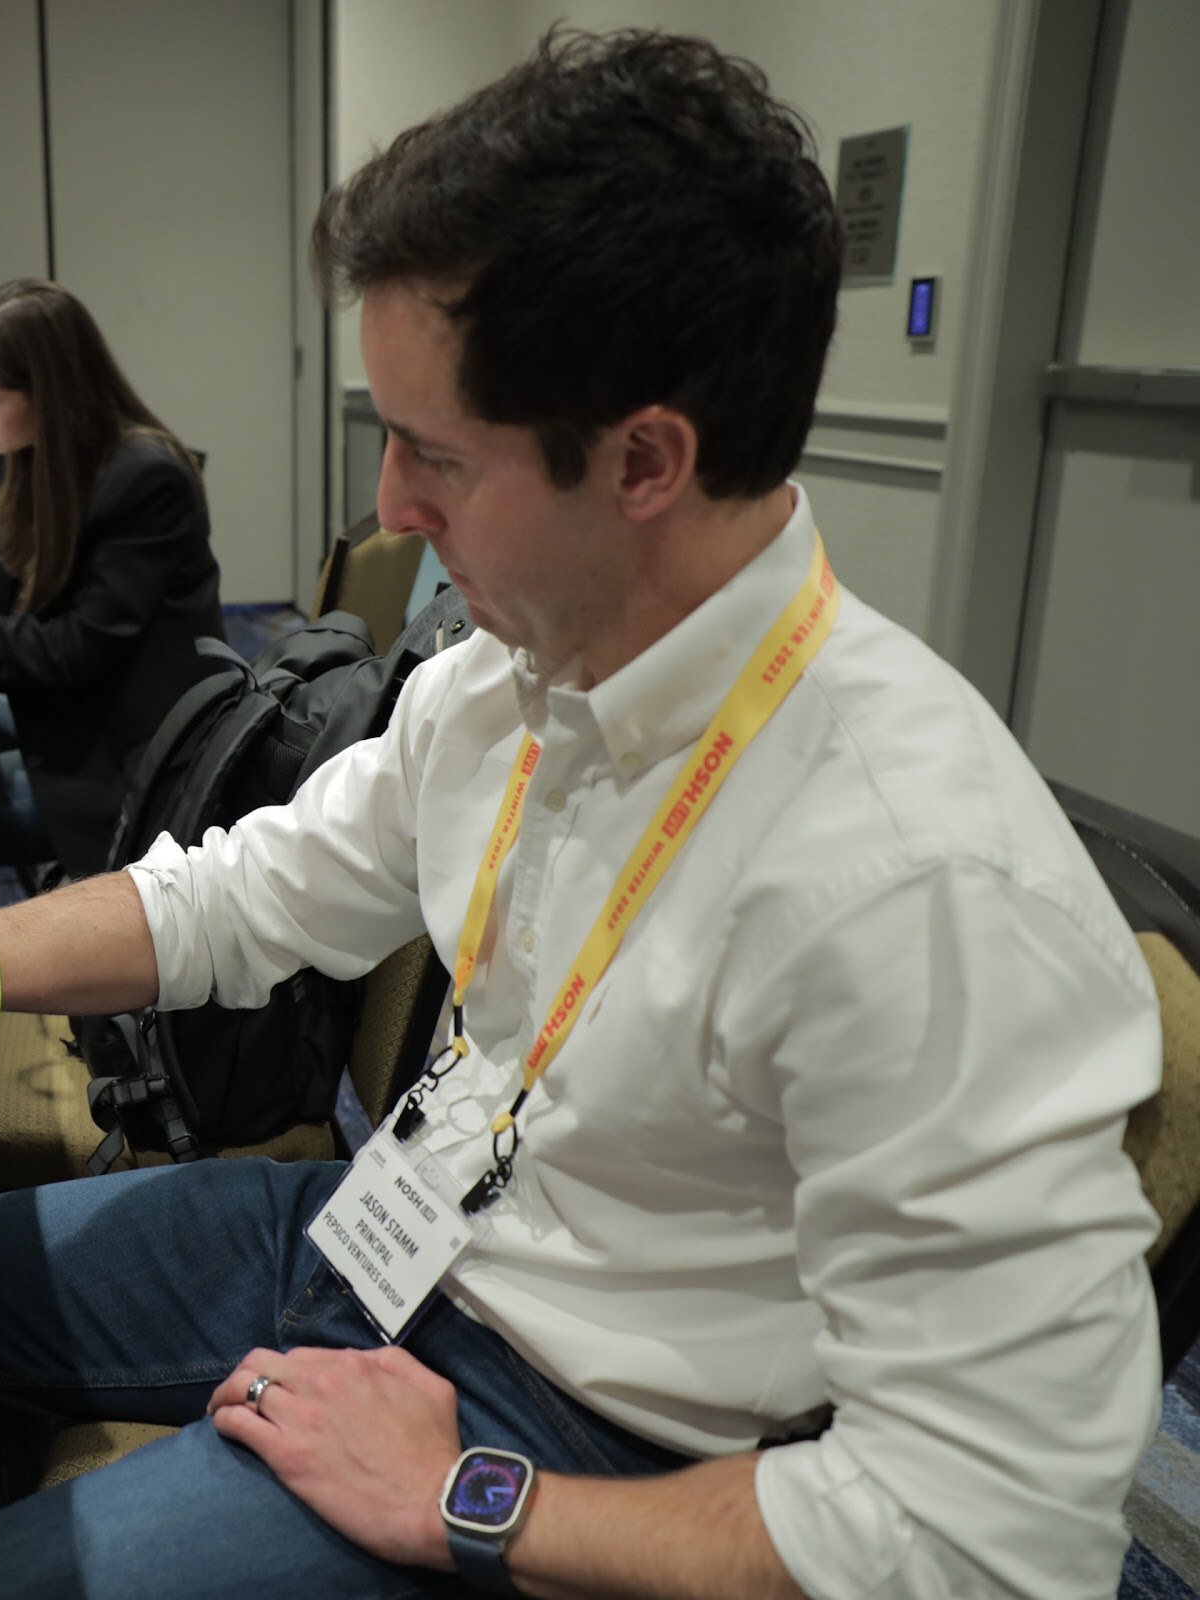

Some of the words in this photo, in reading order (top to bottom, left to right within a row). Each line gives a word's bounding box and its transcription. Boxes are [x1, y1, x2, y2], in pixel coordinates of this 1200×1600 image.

[791, 596, 825, 645] WINTER
[521, 742, 542, 776] LIVE
[682, 731, 735, 804] NOSH
[502, 782, 525, 833] WINTER
[488, 836, 504, 870] 2023
[627, 841, 665, 895] WINTER
[607, 895, 631, 930] 2023
[544, 973, 585, 1037] NOSH
[394, 1176, 423, 1209] NOSH
[355, 1219, 393, 1266] PRINCIPAL
[360, 1191, 390, 1225] JASON
[385, 1219, 419, 1259] STAMM
[323, 1211, 350, 1246] PEPSICO
[347, 1240, 381, 1284] VENTURES
[378, 1278, 406, 1310] GROUP
